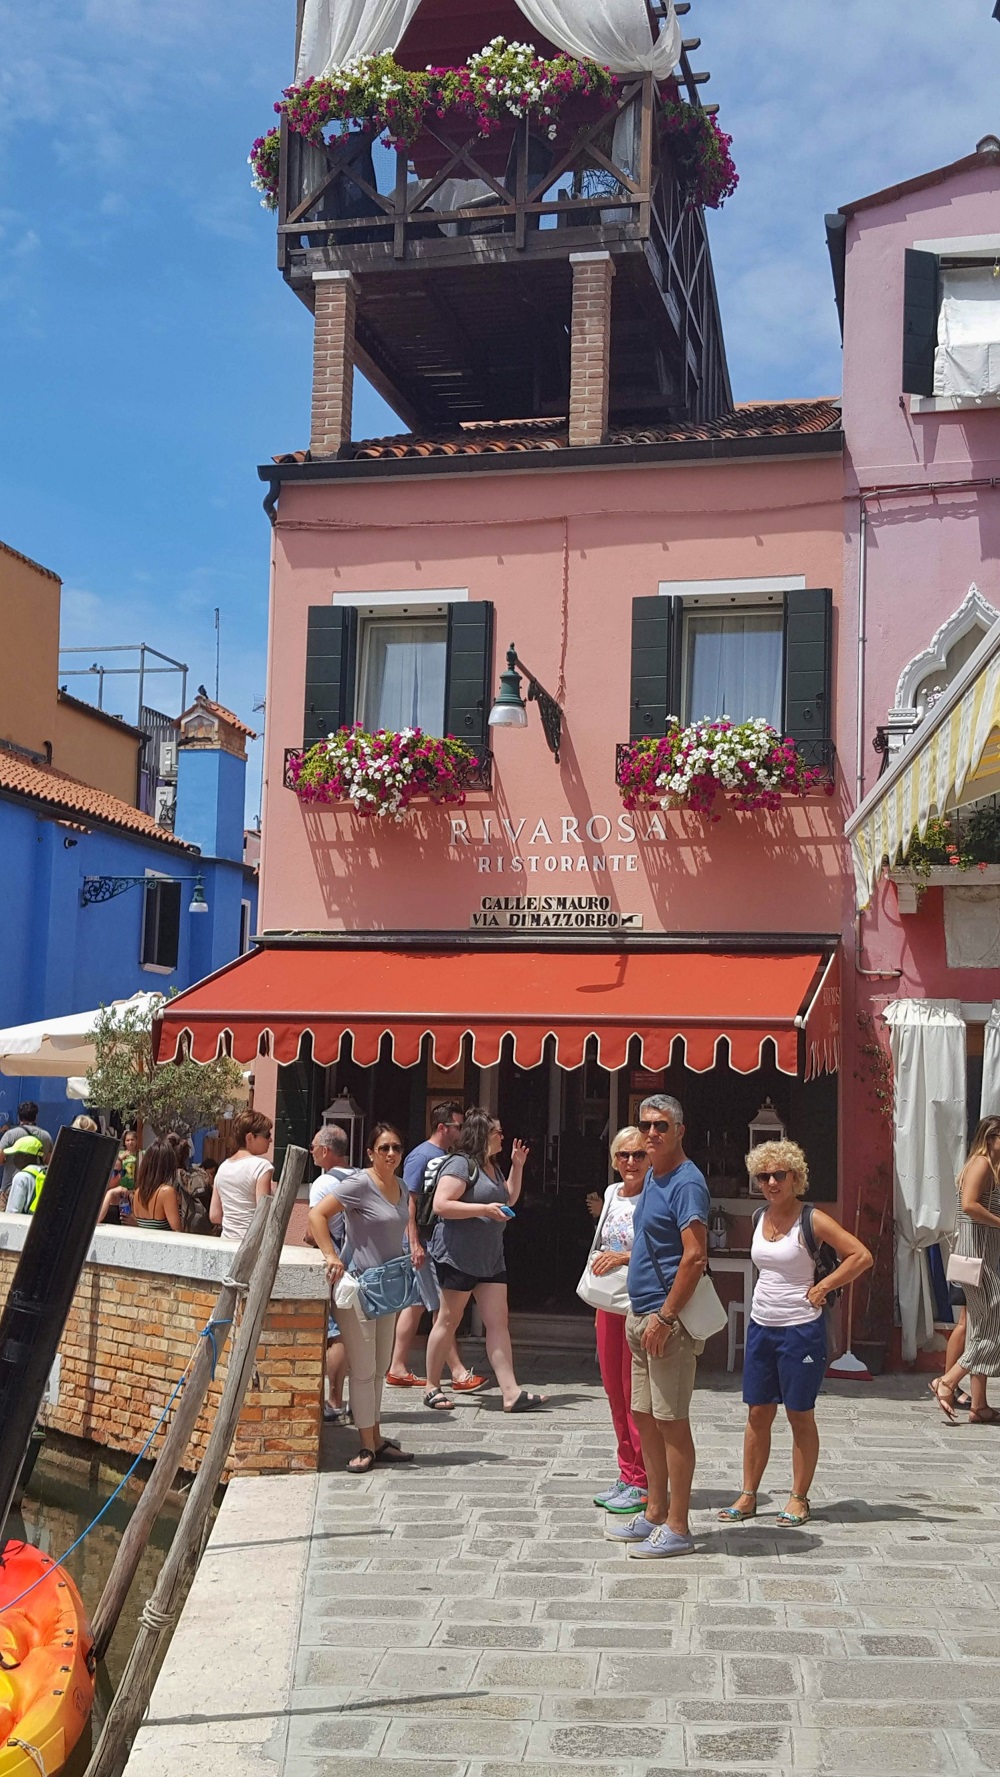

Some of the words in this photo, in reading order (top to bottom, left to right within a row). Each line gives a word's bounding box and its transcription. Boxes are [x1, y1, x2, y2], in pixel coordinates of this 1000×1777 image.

[449, 813, 669, 846] RIVAROSA
[477, 854, 639, 873] RISTORANTE
[481, 896, 537, 910] CALLE
[472, 913, 500, 926] VIA
[508, 913, 527, 927] DI
[529, 913, 618, 927] MAZZORBO
